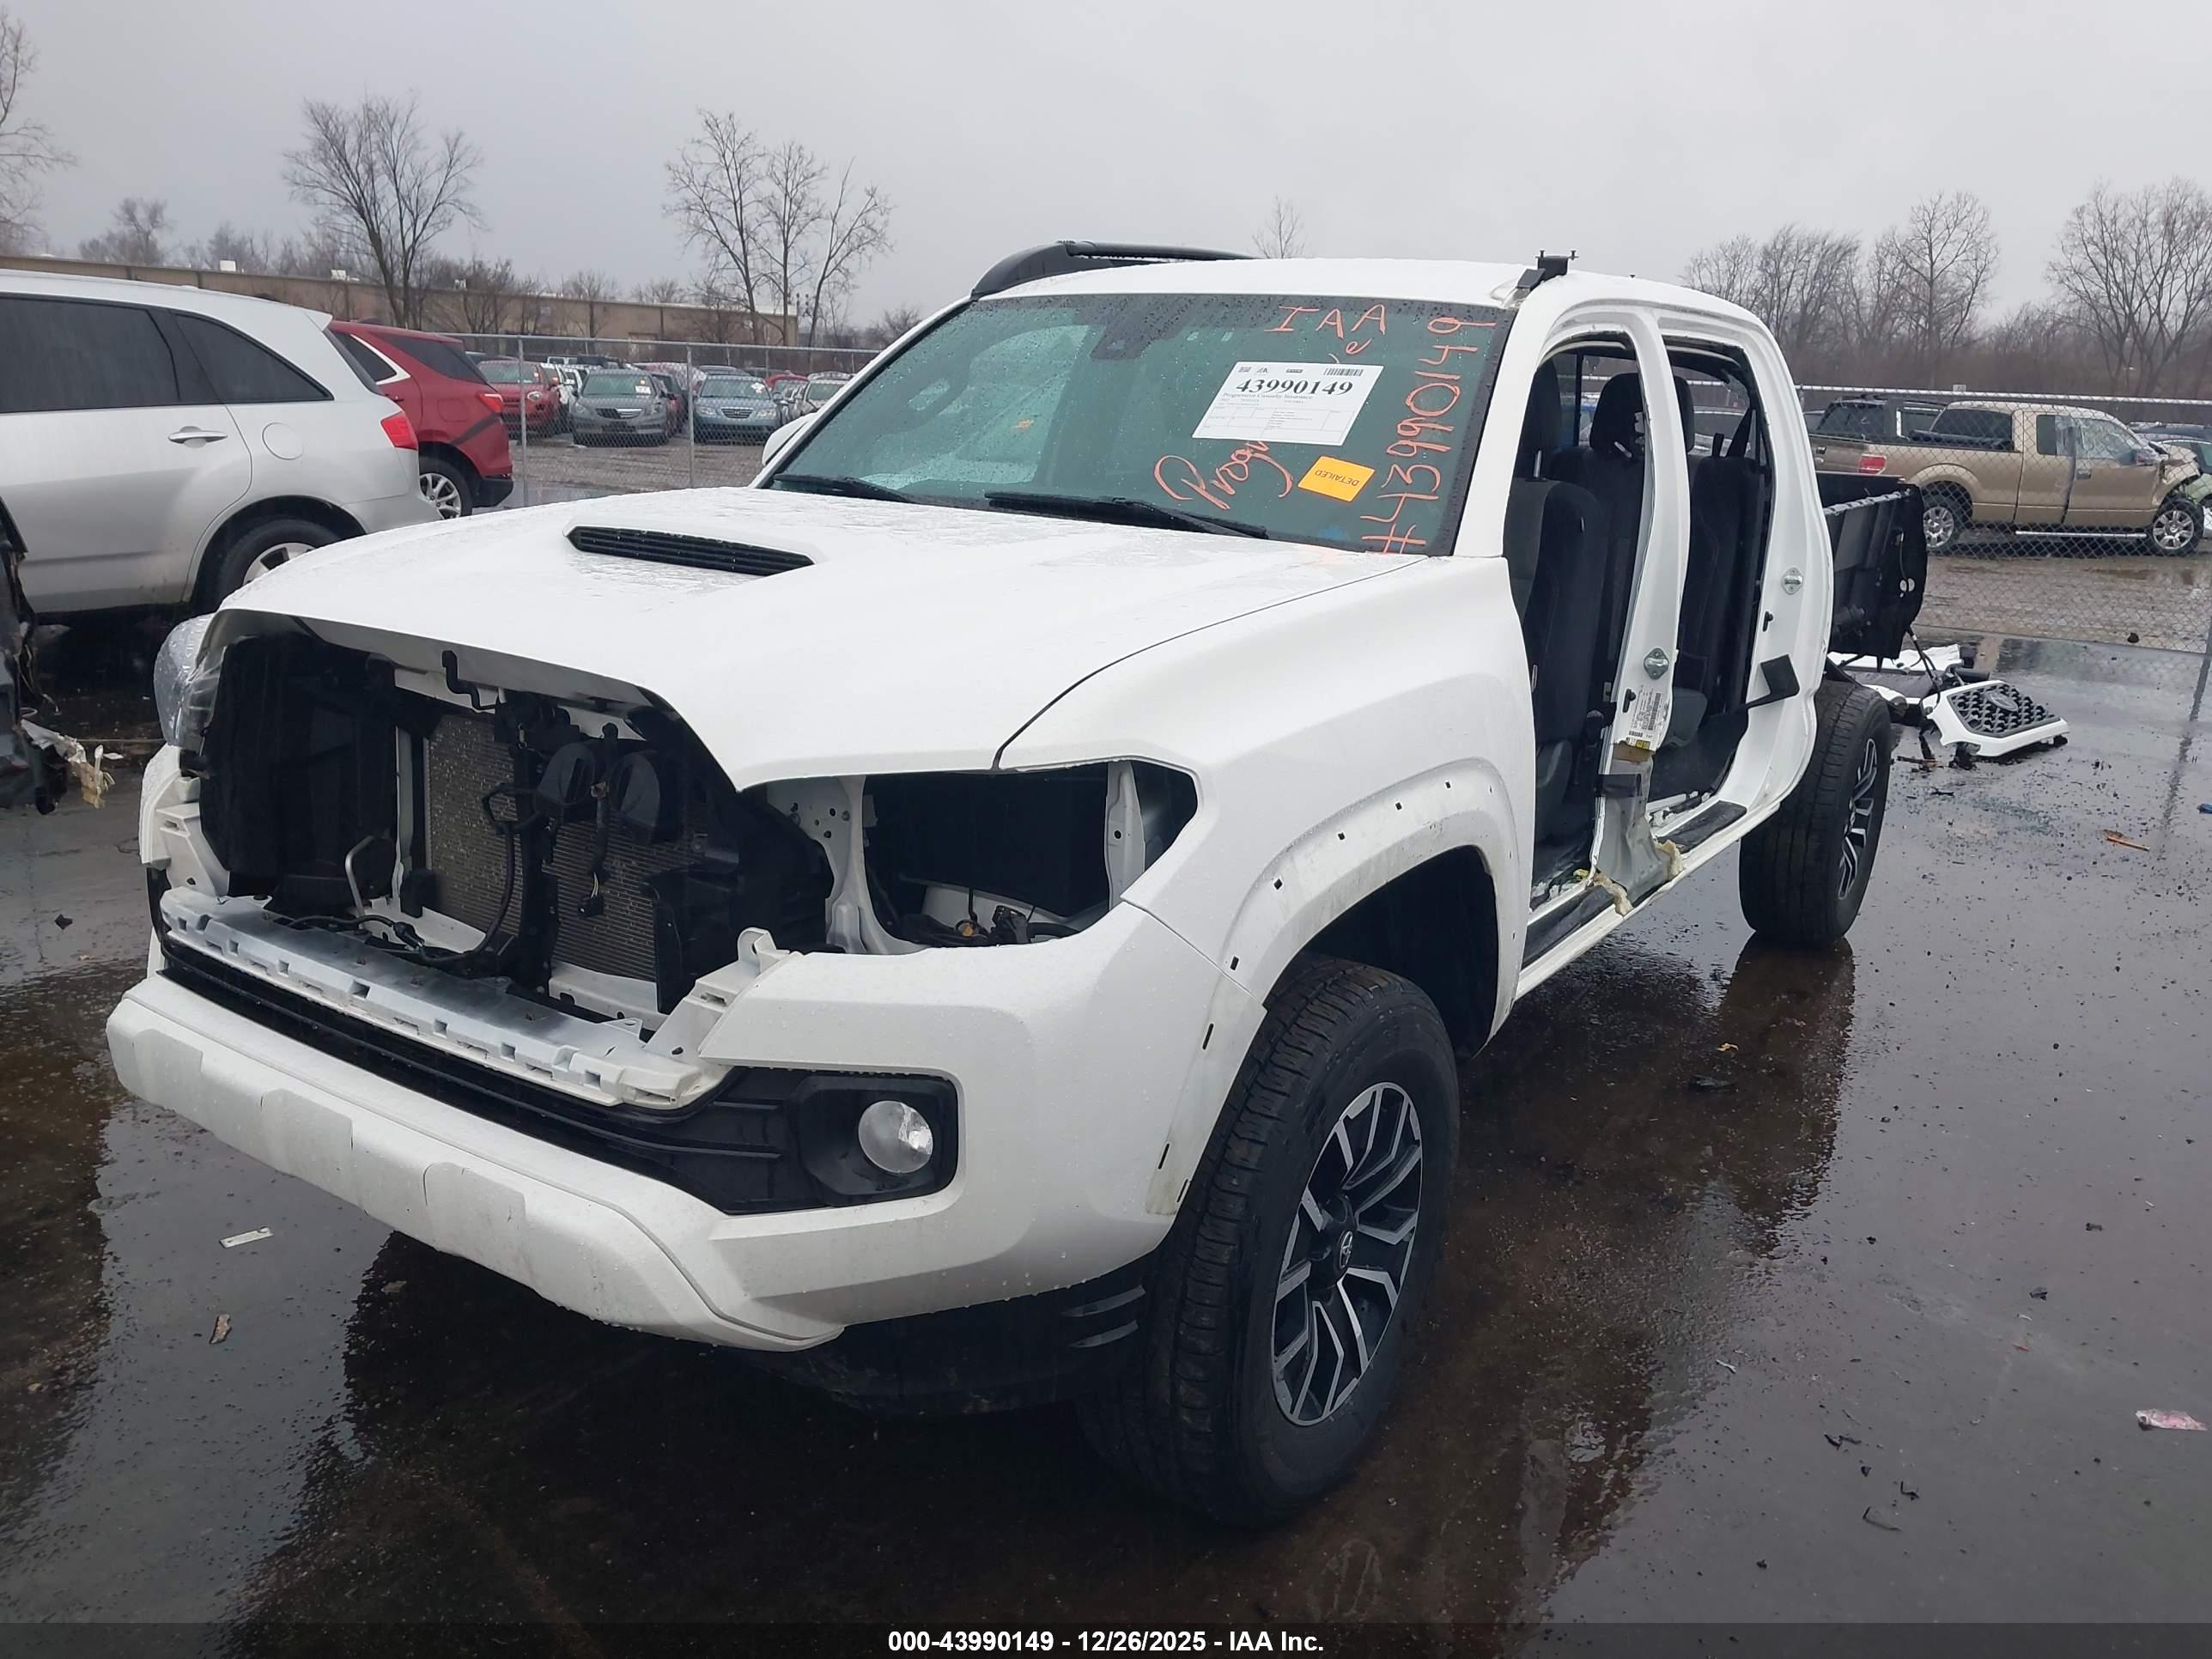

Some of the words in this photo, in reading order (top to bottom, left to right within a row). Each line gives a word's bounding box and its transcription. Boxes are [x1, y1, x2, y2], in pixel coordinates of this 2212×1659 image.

[1264, 304, 1386, 339] IAA
[1236, 378, 1353, 396] 43990149
[1314, 469, 1360, 487] DETAILED
